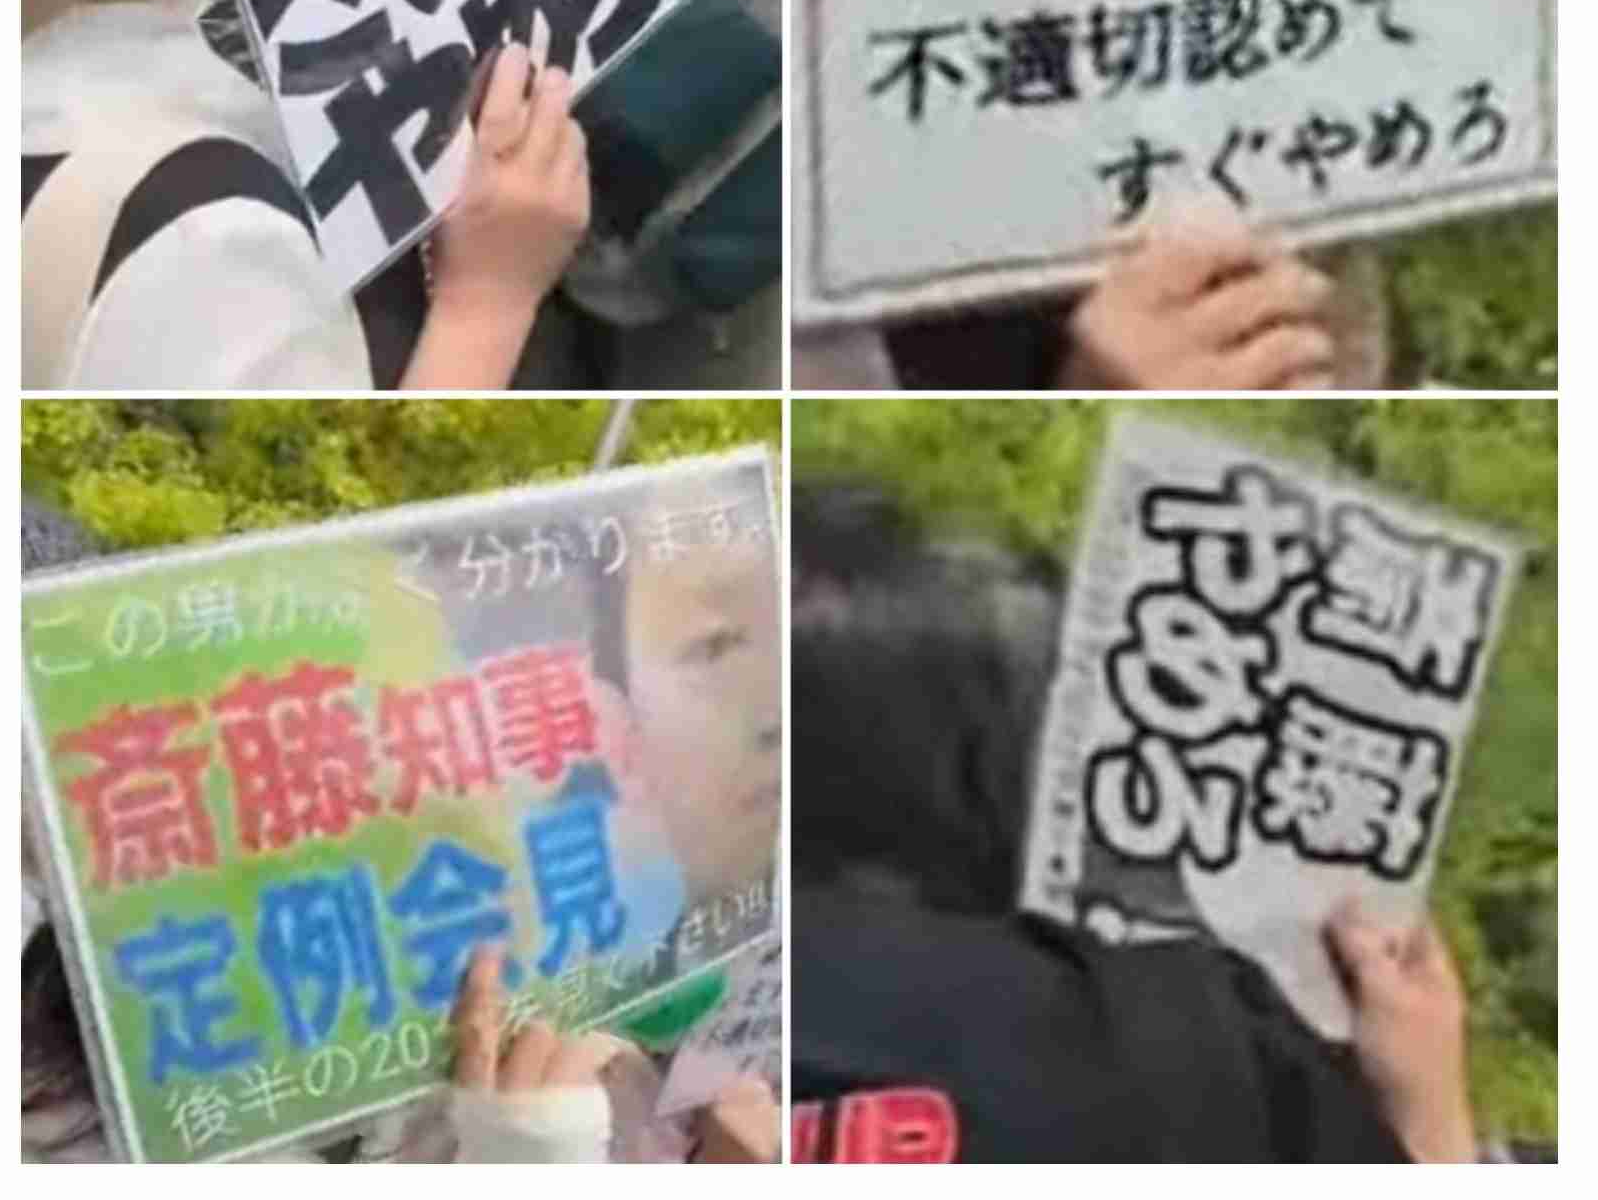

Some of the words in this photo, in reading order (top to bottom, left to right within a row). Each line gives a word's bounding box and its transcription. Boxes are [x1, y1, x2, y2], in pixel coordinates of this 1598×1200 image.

[1096, 81, 1508, 225] すぐやめろ
[55, 641, 601, 893] 斎藤知事
[111, 759, 628, 1085] 定例会見
